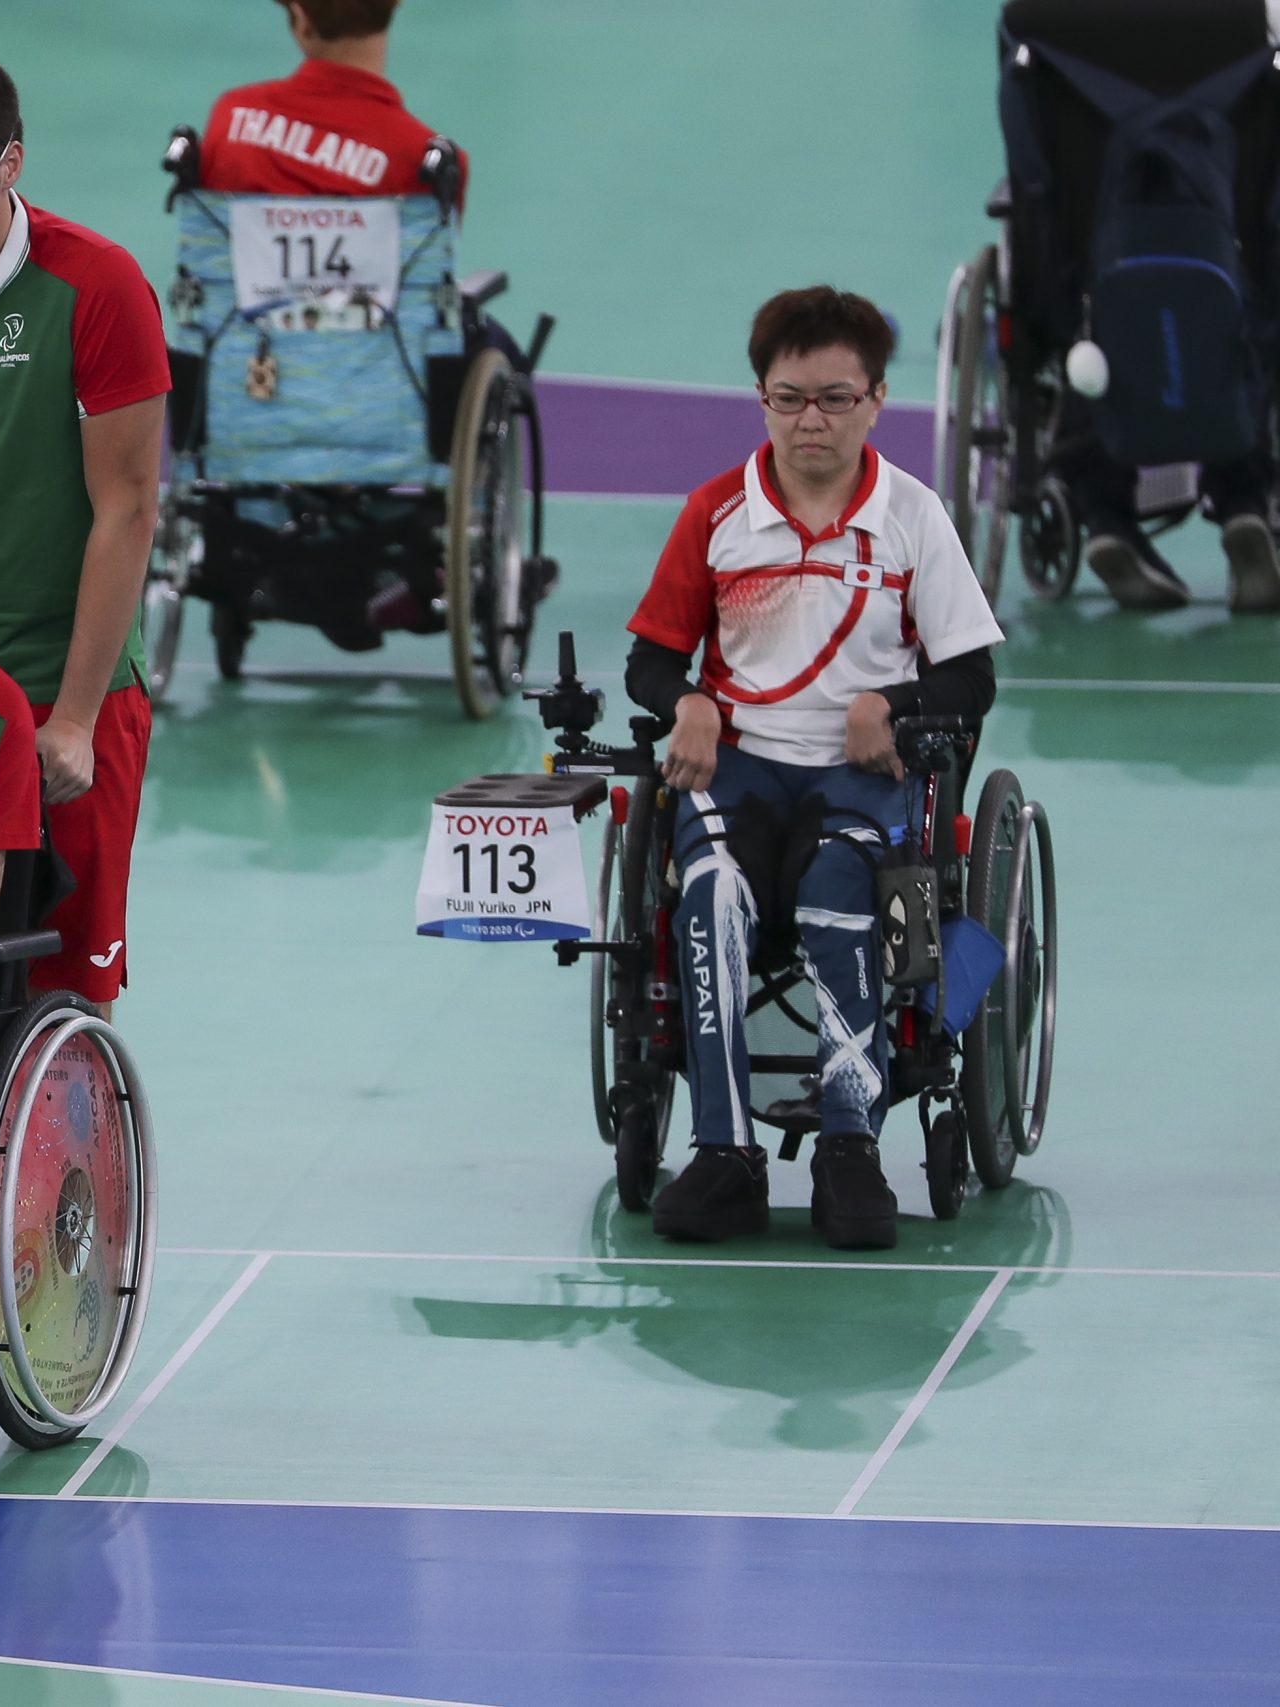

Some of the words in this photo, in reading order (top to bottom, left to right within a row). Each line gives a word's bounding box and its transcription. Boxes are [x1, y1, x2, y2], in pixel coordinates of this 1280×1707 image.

[227, 106, 389, 187] THAILAND
[263, 207, 367, 229] TOYOTA
[273, 235, 352, 279] 114
[445, 815, 549, 837] TOYOTA
[453, 843, 537, 894] 113
[446, 899, 475, 913] FUJII
[479, 901, 516, 914] Yuriko
[525, 900, 552, 913] JPN
[462, 924, 489, 935] TOKYO
[489, 924, 513, 935] 2020
[688, 916, 718, 1035] JAPAN
[88, 1070, 100, 1149] APCAS
